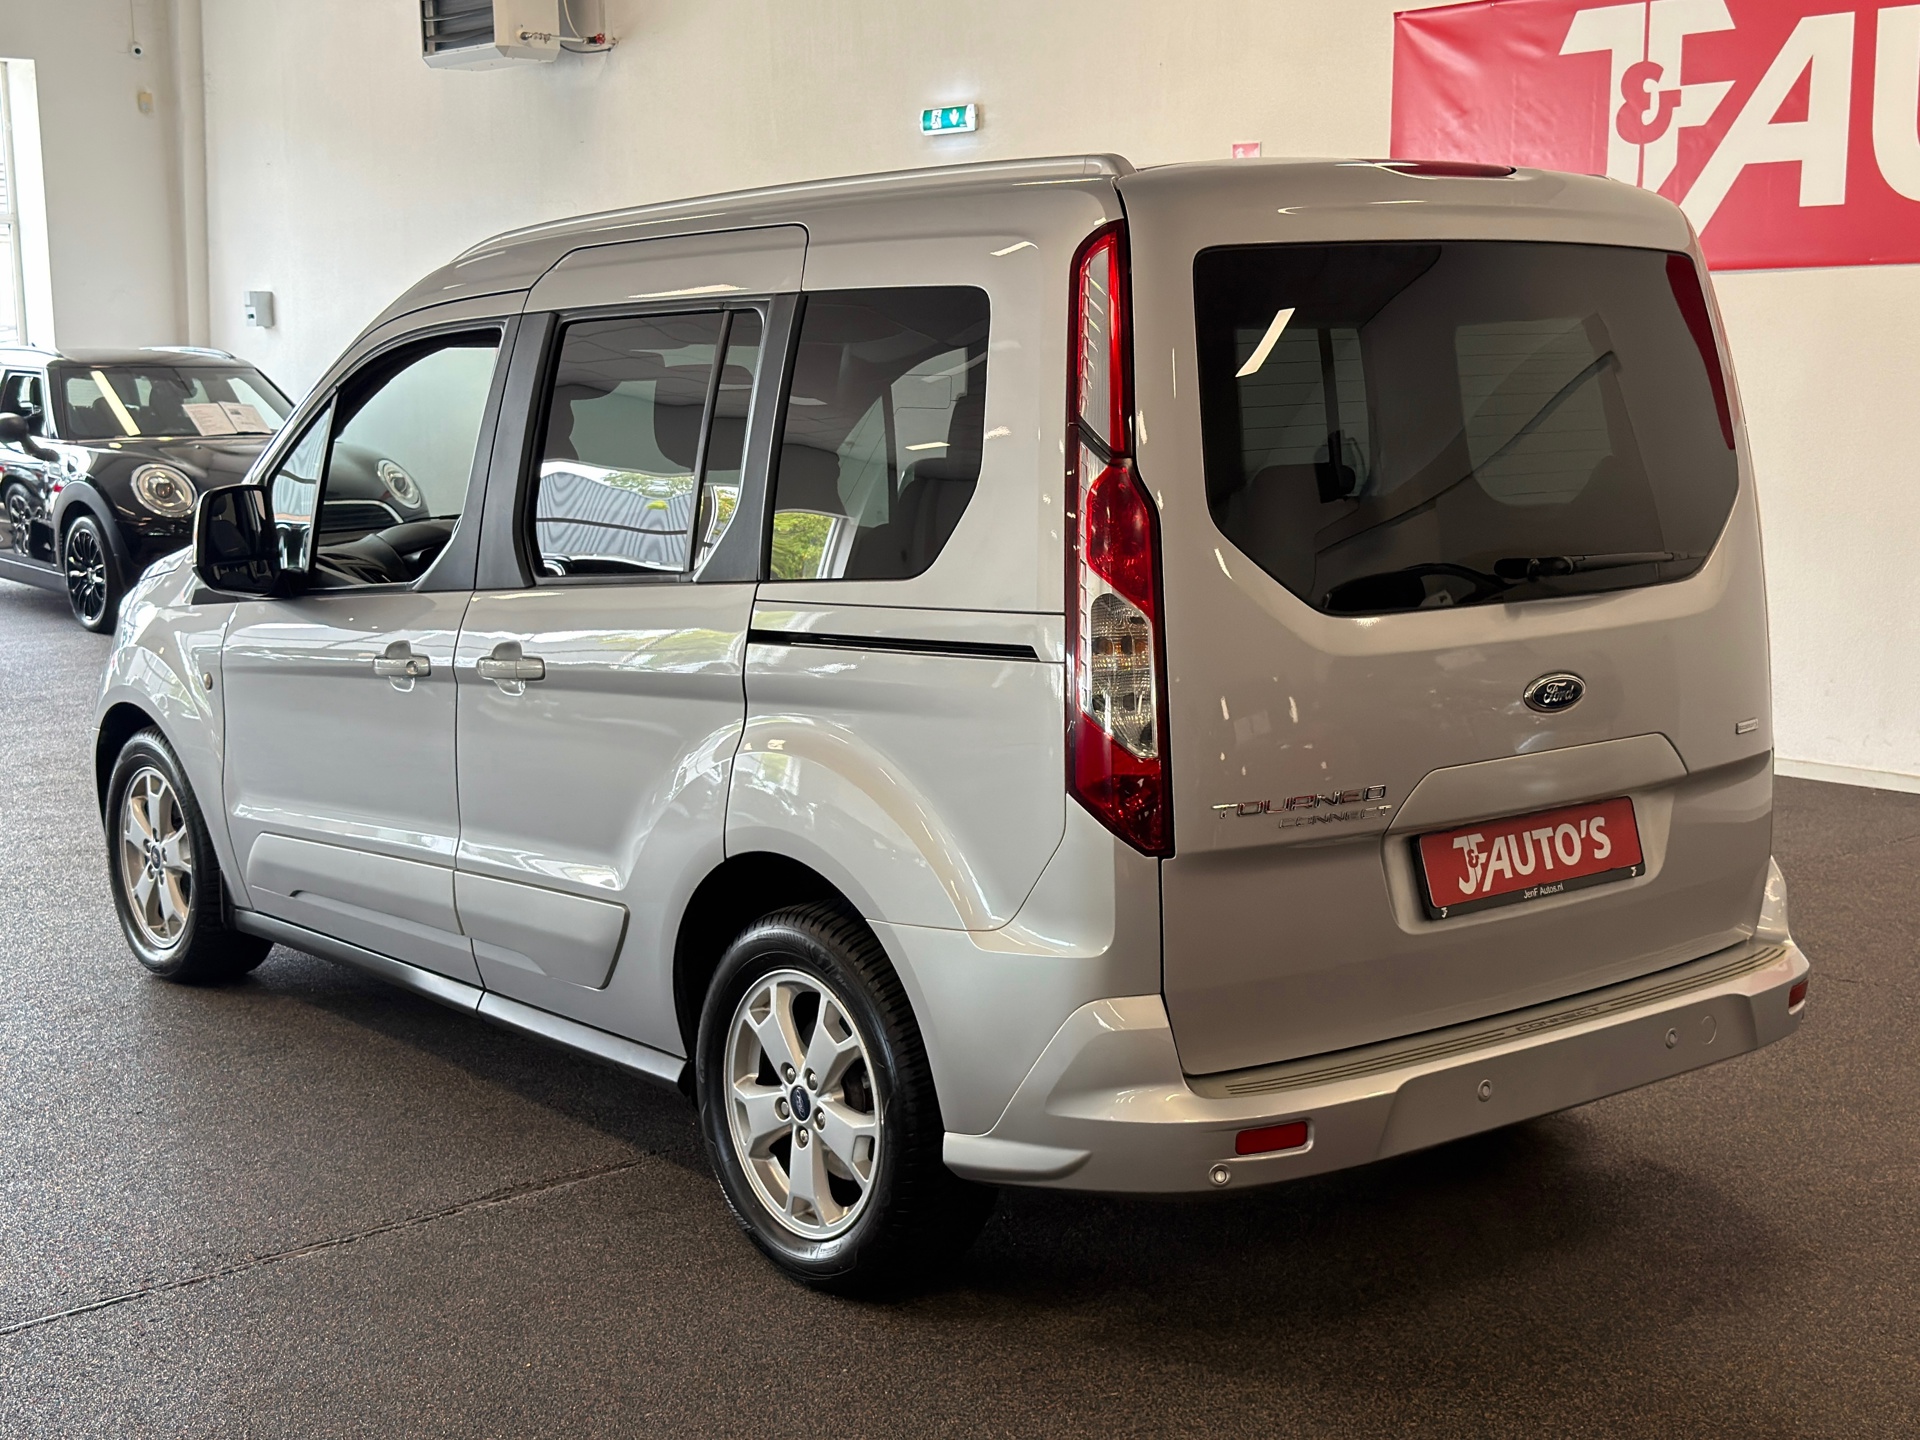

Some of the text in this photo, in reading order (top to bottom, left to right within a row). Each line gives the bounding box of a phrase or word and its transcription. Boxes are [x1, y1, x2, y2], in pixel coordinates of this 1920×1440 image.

[1542, 681, 1575, 704] Ford
[1211, 784, 1387, 820] TOURNEO
[1278, 804, 1393, 829] CONNECT
[1482, 816, 1612, 893] AUTO'S
